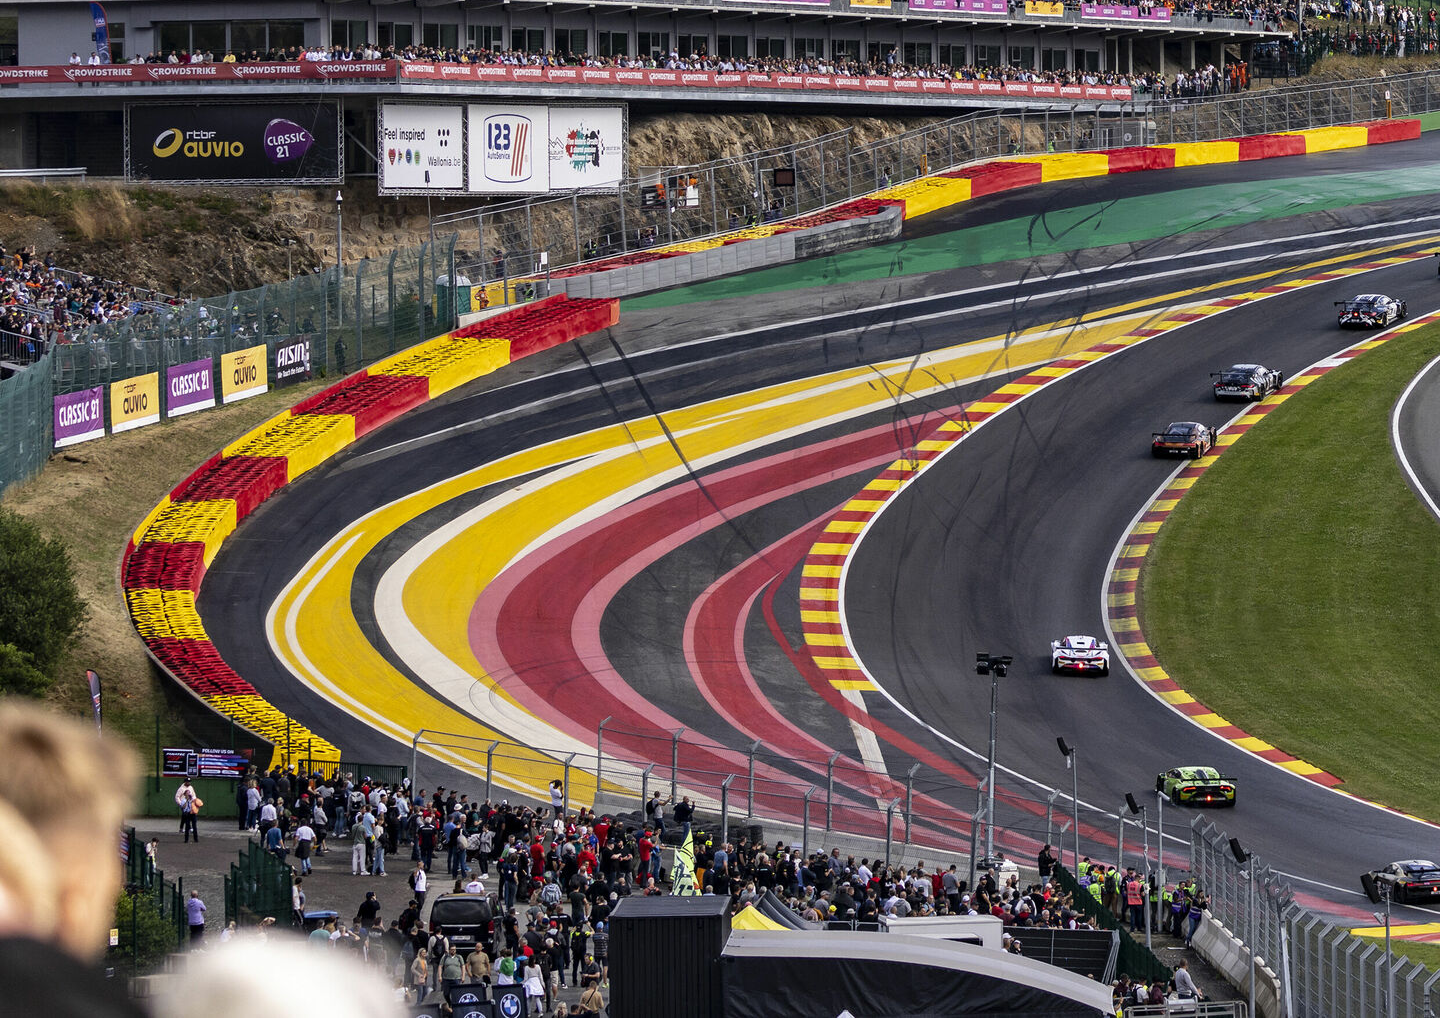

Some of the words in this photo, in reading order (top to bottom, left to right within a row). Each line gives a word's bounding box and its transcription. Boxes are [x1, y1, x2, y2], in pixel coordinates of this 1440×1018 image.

[69, 68, 132, 77] CROWDSTRIKE
[153, 67, 216, 75] CROWDSTRIKE
[237, 65, 300, 74] CROWDSTRIKE
[322, 64, 386, 72] CROWDSTRIKE
[442, 66, 470, 74] CROWDSTRIKE
[187, 130, 216, 139] rtbf
[267, 132, 305, 146] CLASSIC
[384, 128, 397, 140] Feel
[400, 128, 425, 142] inspired
[184, 142, 244, 158] auvio
[276, 145, 289, 158] 21
[487, 152, 510, 160] AutoService
[428, 156, 461, 166] Wallonia.be
[277, 343, 304, 367] AISIN
[234, 365, 257, 385] auvio
[172, 375, 200, 397] CLASSIC
[201, 370, 210, 389] 21
[123, 394, 148, 414] auvio
[59, 404, 89, 427] CLASSIC
[91, 398, 99, 418] 21
